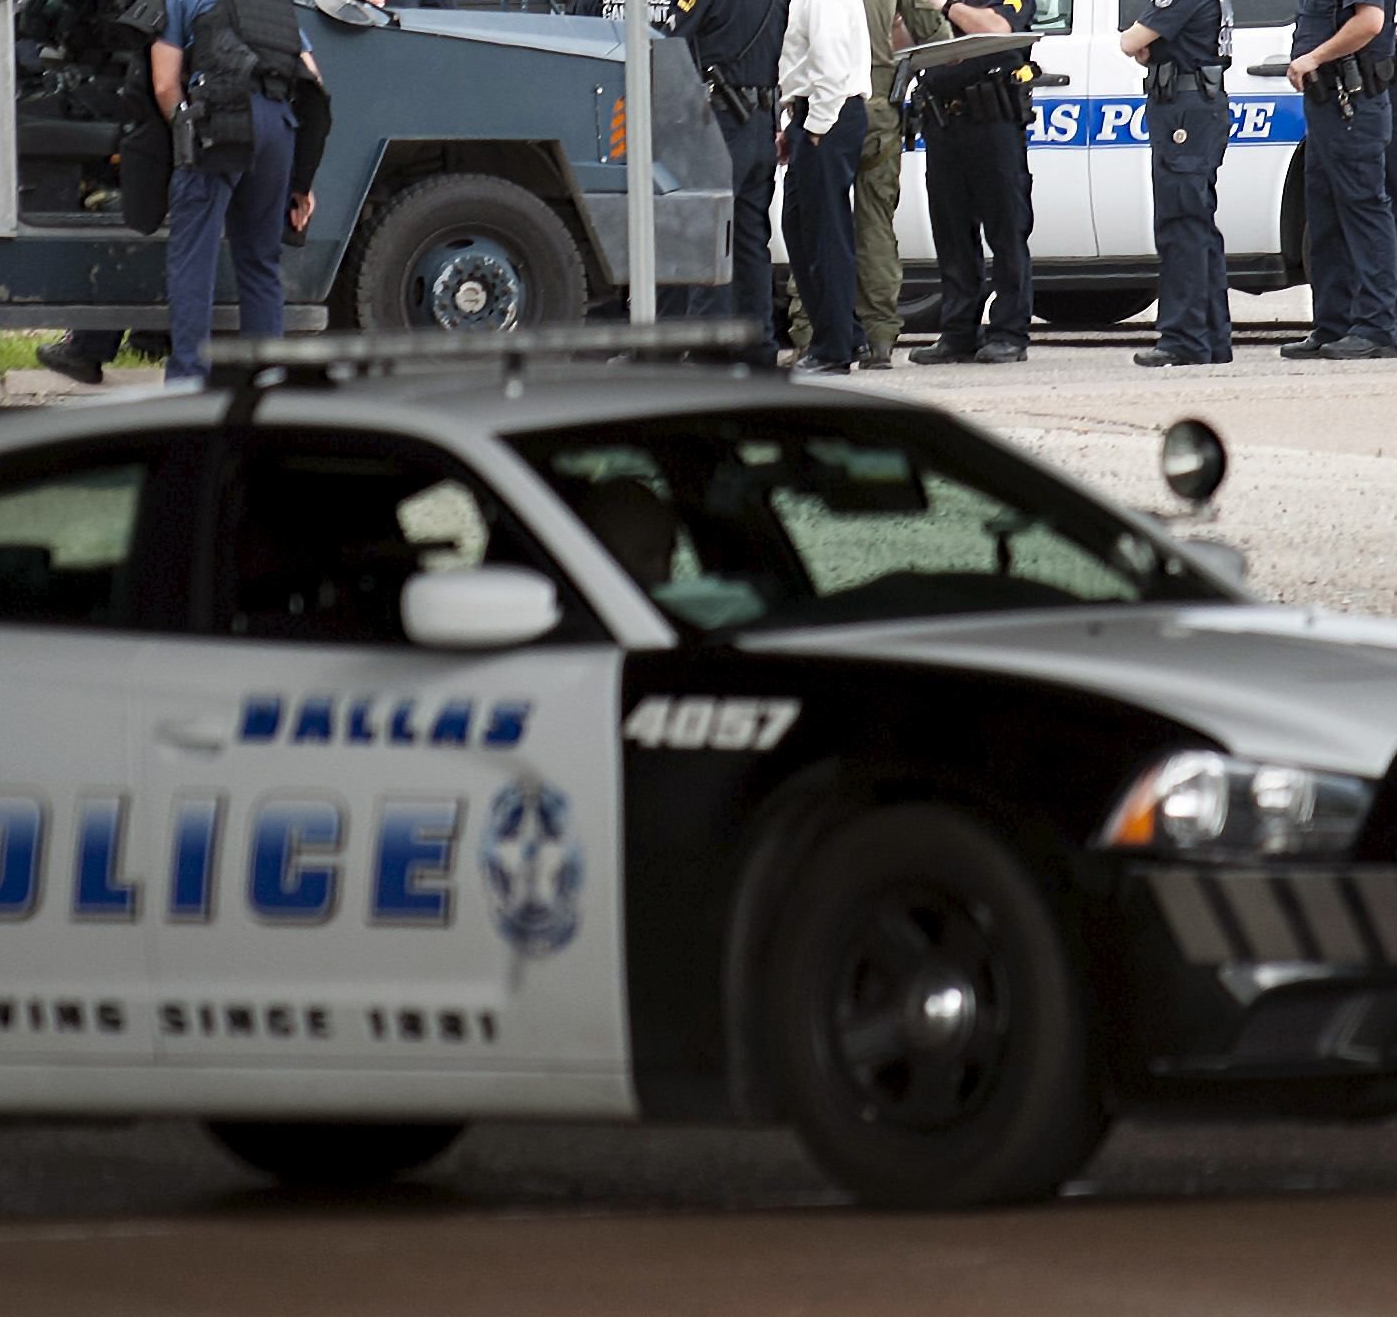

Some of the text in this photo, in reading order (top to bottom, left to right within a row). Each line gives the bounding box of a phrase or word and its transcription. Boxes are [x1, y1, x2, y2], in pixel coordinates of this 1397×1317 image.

[238, 694, 533, 748] DALLAS
[624, 694, 801, 750] 4057
[158, 1004, 331, 1040] SINCE
